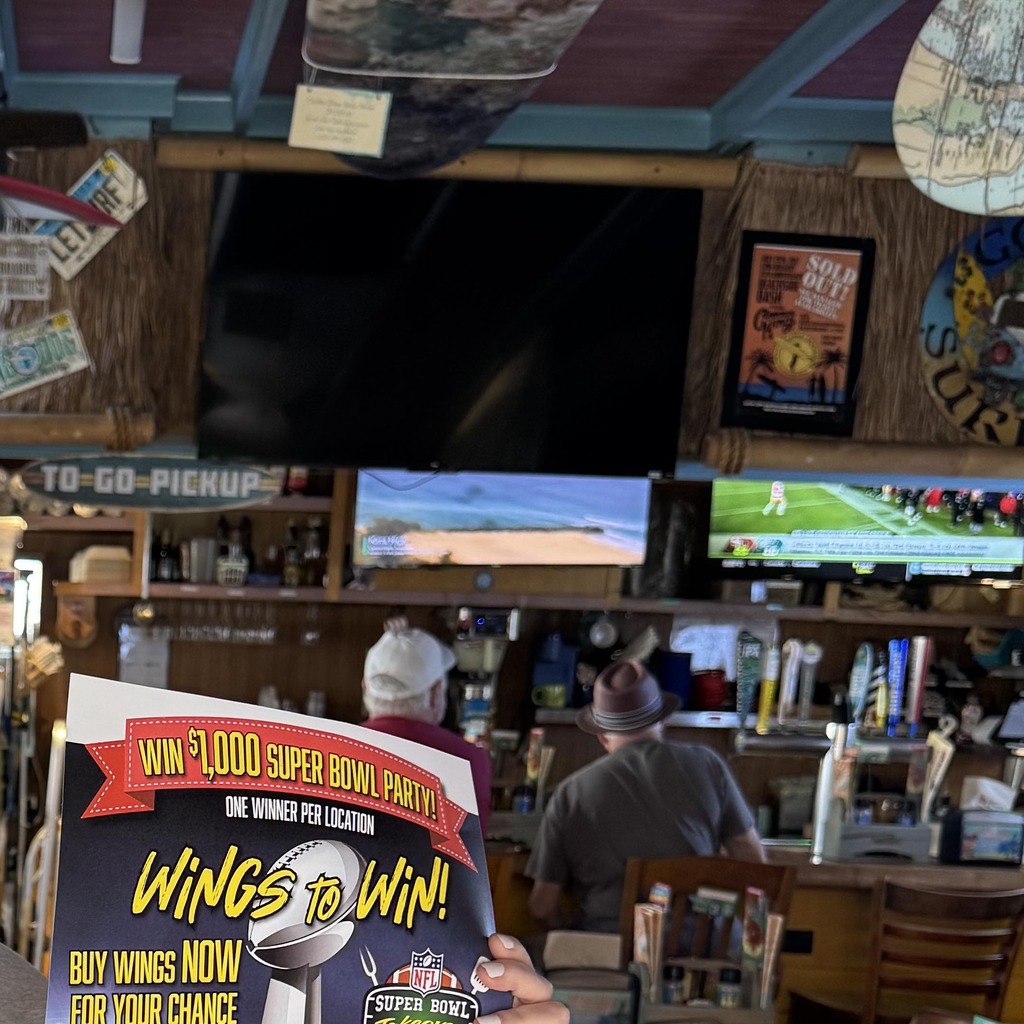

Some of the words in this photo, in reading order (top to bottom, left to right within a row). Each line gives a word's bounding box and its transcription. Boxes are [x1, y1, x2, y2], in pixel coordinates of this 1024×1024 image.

[802, 271, 851, 302] OUT!
[806, 253, 857, 287] SOLD
[41, 464, 79, 493] TO
[94, 467, 136, 495] GO
[149, 467, 261, 498] PICKUP
[137, 738, 184, 776] WIN
[187, 726, 261, 781] $1,000
[266, 743, 324, 785] SUPER
[329, 752, 380, 798] BOWL
[383, 768, 437, 820] PARTY!
[226, 795, 248, 819] ONE
[252, 797, 298, 822] WINNER
[300, 801, 323, 826] PER
[325, 806, 375, 836] LOCATION
[69, 951, 108, 985] BUY
[113, 950, 176, 984] WINGS
[181, 939, 243, 984] NOW
[414, 969, 437, 990] NFL
[375, 995, 423, 1012] SUPER
[430, 998, 470, 1019] BOWL
